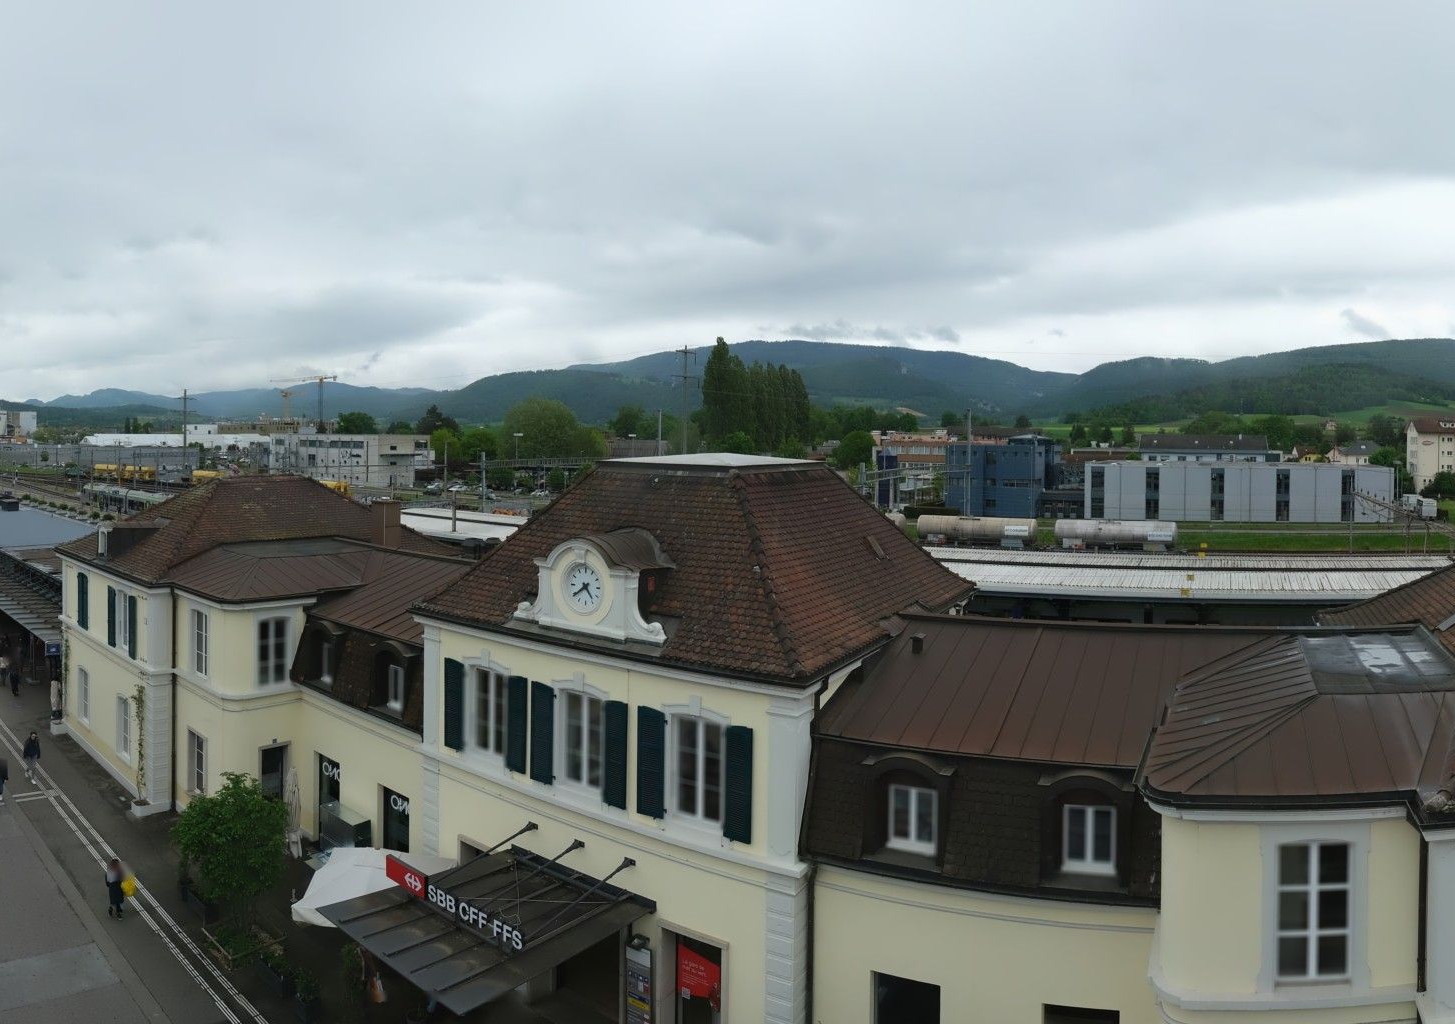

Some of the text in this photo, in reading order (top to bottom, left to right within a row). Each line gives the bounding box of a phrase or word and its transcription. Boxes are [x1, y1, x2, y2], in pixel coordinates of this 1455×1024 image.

[427, 884, 523, 950] SBB CFF FFS
